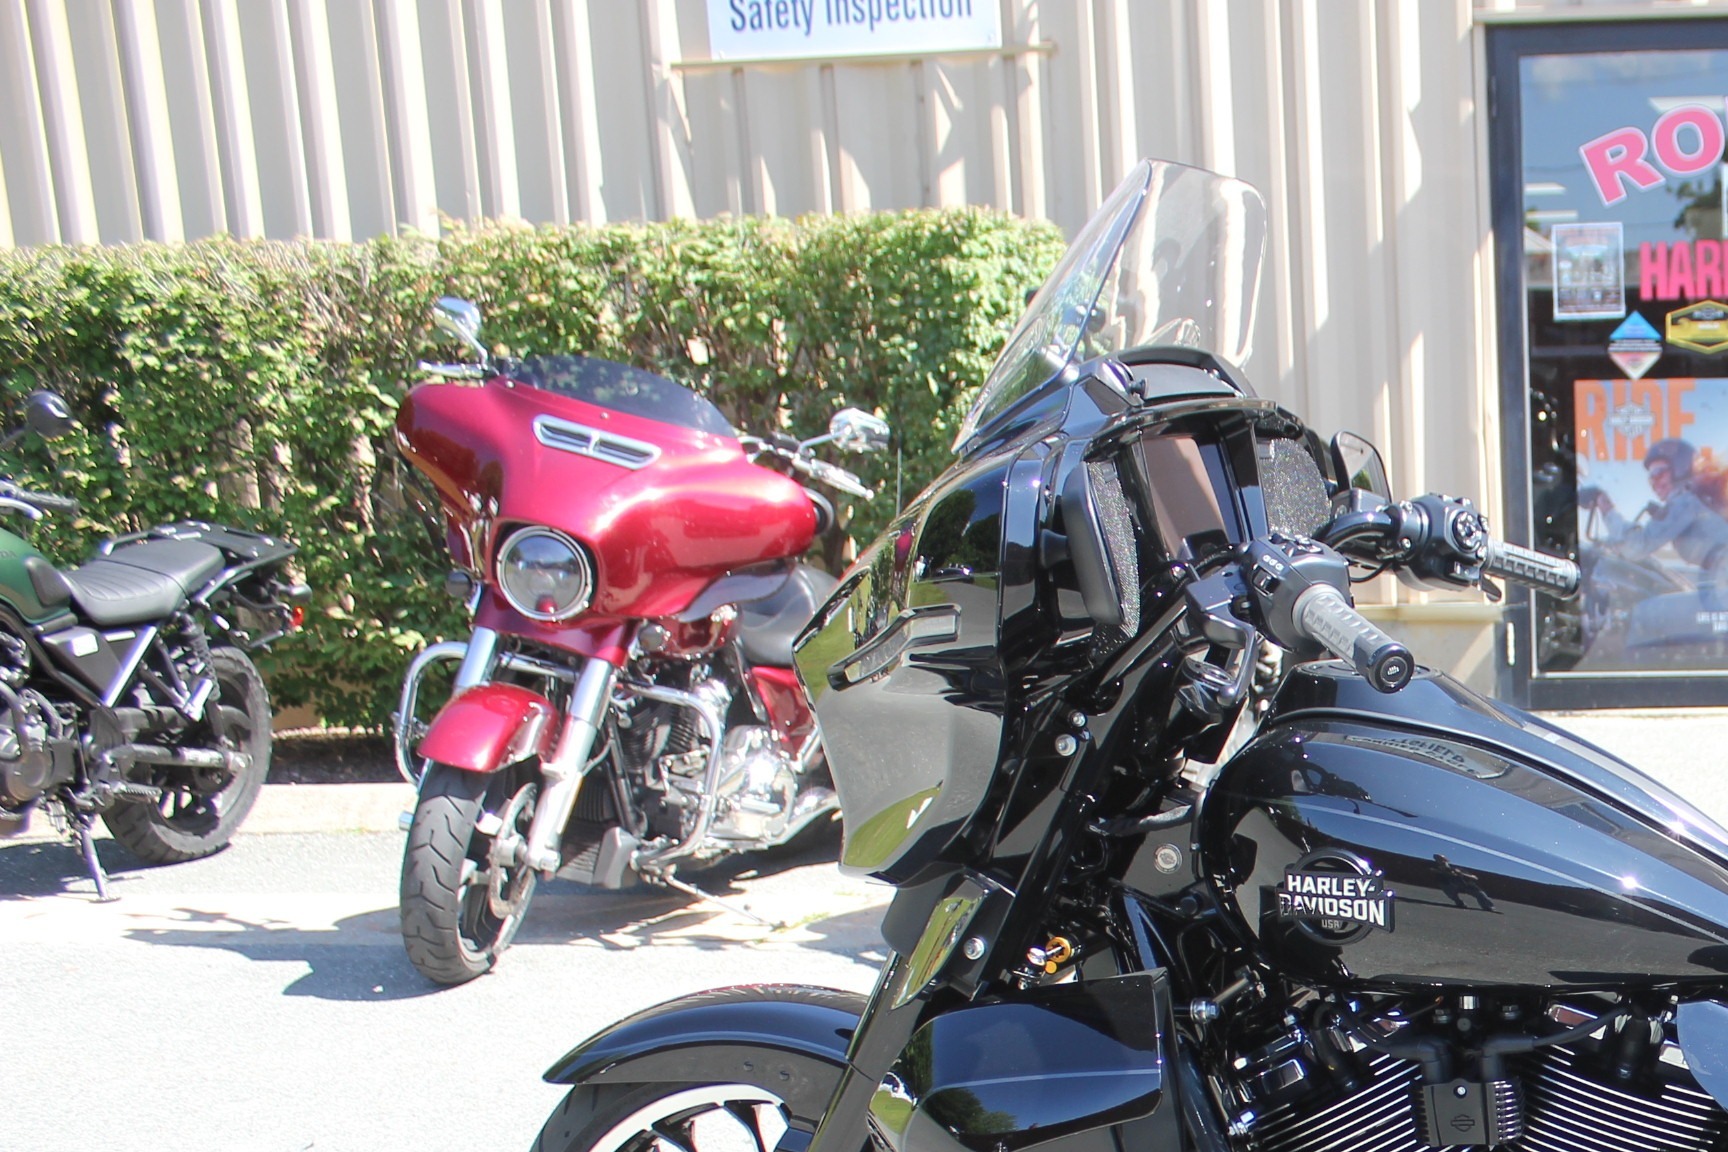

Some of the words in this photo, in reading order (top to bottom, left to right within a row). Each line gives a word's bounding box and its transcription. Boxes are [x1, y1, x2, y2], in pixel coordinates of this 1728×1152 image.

[730, 0, 812, 36] Safety
[1287, 874, 1376, 897] HARLEY-
[1278, 893, 1385, 927] DAVIDSON
[1321, 919, 1340, 929] USA
